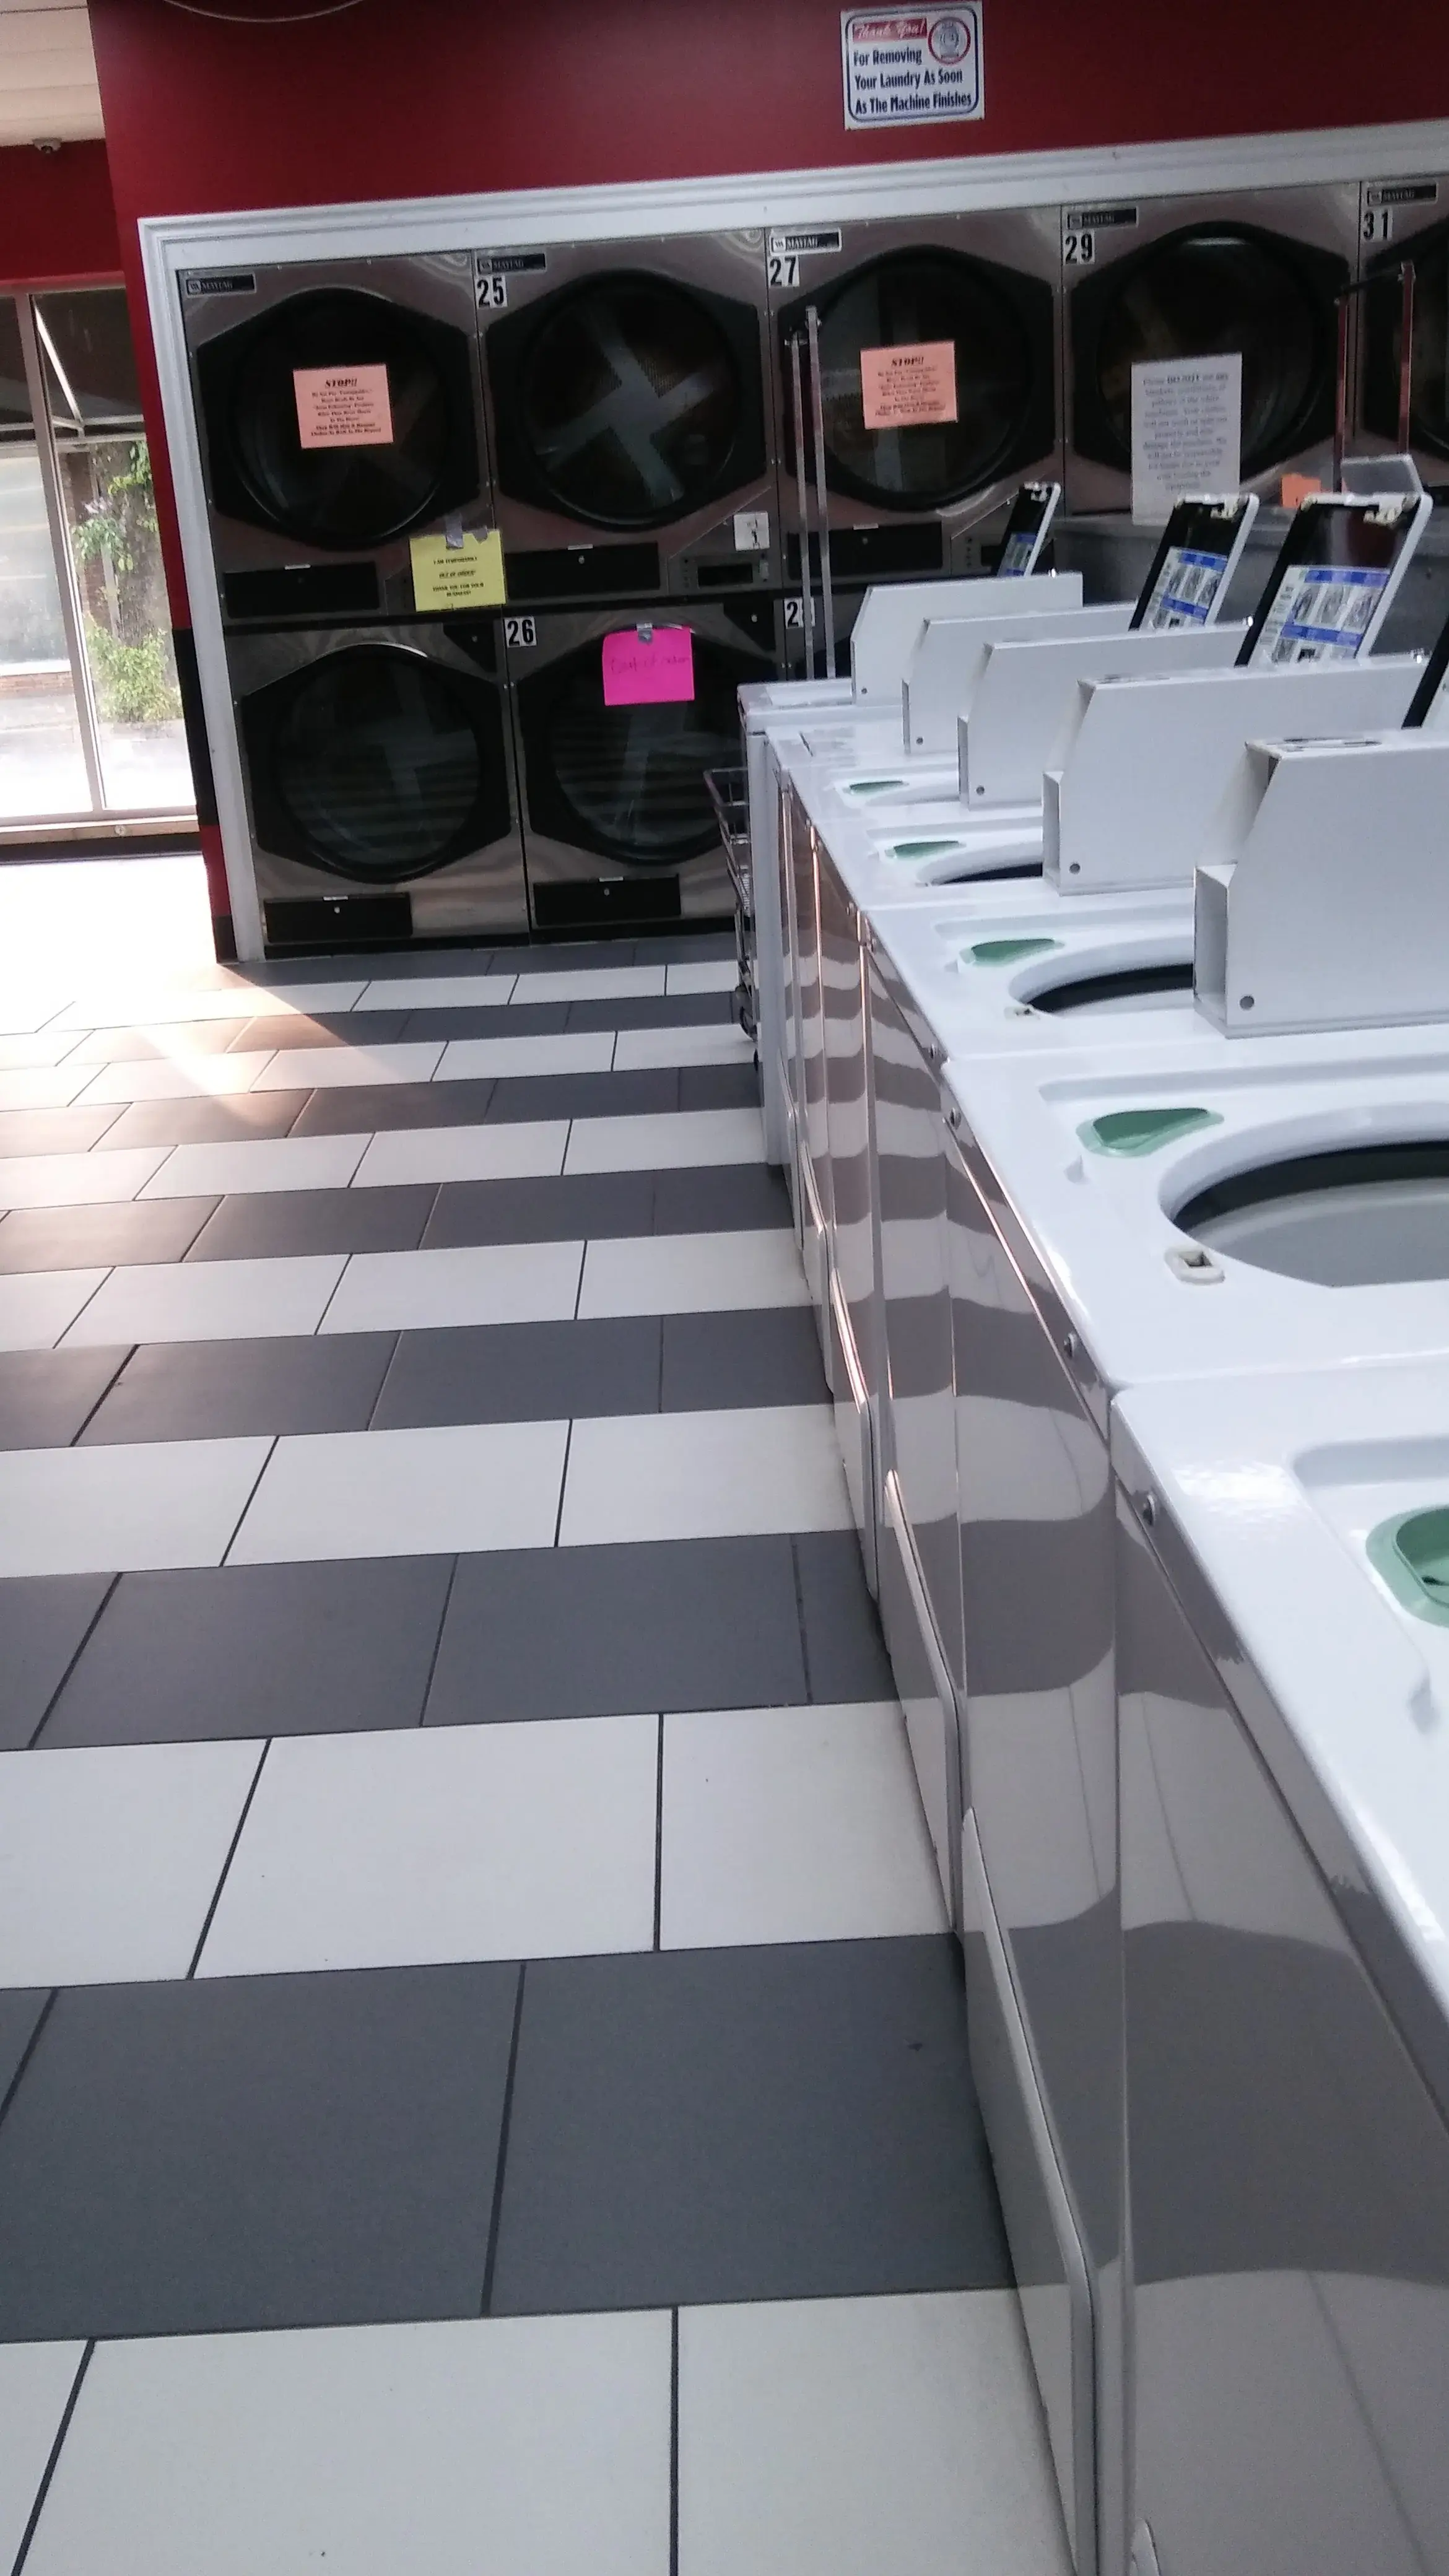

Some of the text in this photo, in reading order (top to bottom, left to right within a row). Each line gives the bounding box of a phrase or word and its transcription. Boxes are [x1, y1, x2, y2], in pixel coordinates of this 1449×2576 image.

[855, 18, 926, 39] Thank You!
[853, 46, 922, 66] For Removing
[855, 68, 963, 90] Your Laundry As Soon
[855, 91, 972, 115] As The Machine Finishes
[1363, 211, 1388, 240] 31
[1065, 233, 1092, 264] 29
[769, 256, 796, 286] 27
[477, 276, 504, 308] 25
[508, 619, 533, 646] 26
